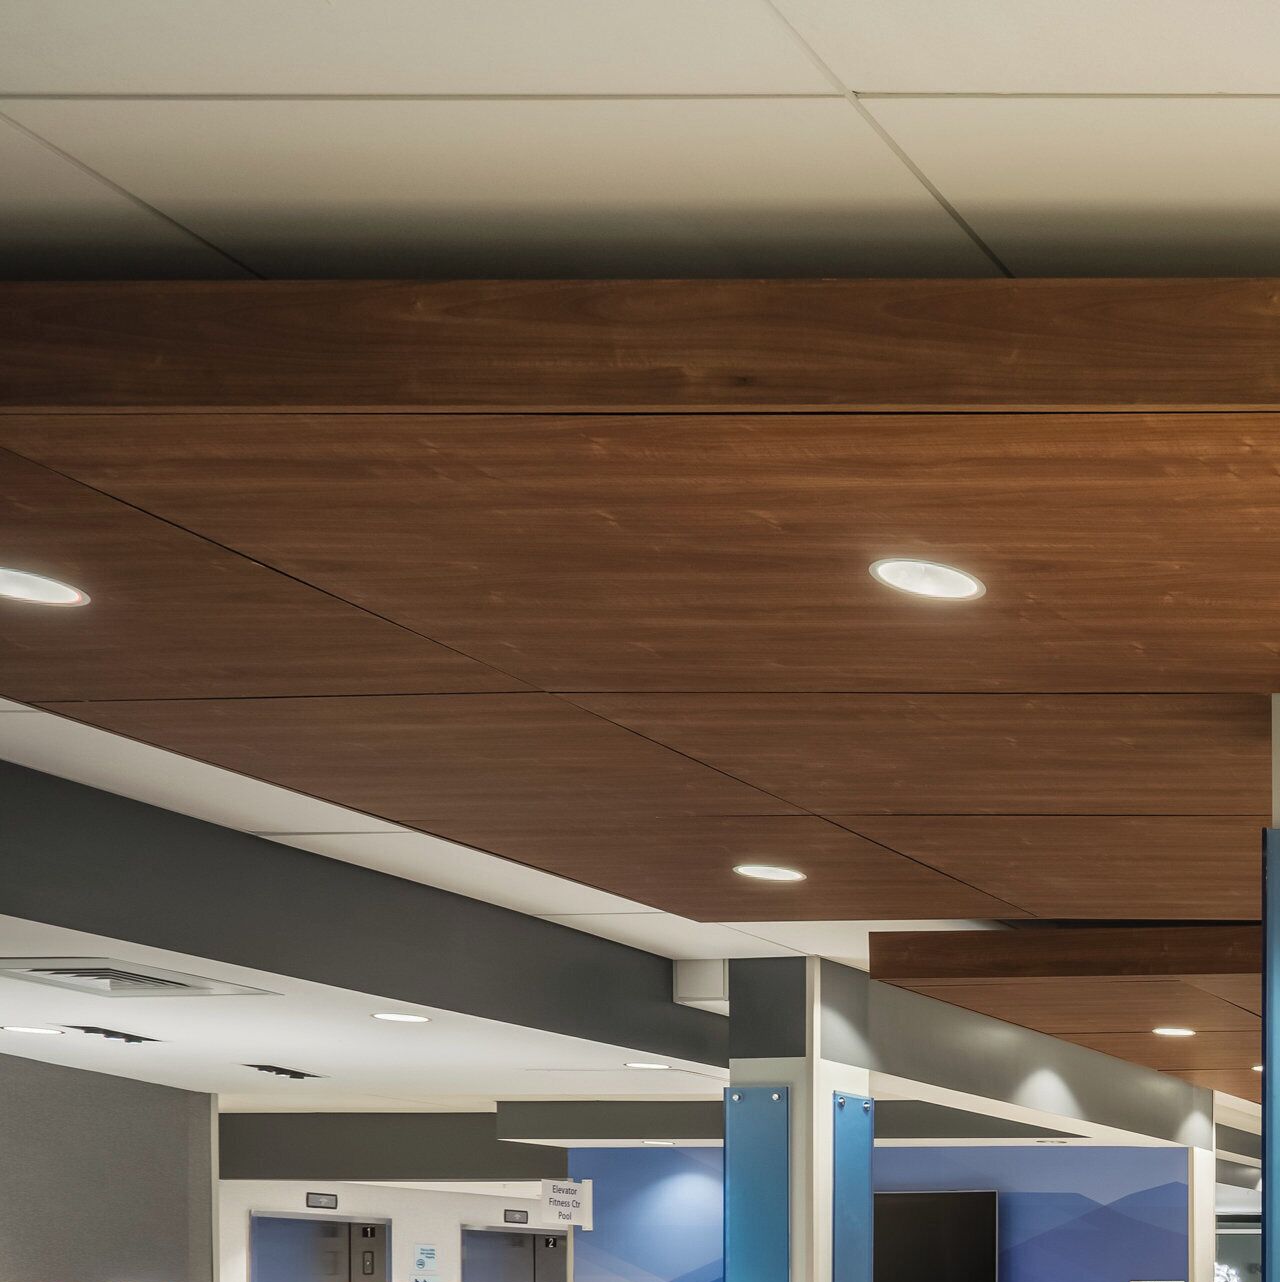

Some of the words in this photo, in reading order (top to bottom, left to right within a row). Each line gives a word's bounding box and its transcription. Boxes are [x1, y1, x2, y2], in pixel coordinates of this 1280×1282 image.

[552, 1184, 578, 1195] Elevator
[549, 1197, 570, 1208] Fitness
[571, 1199, 581, 1208] Ctr
[558, 1211, 572, 1220] Pool
